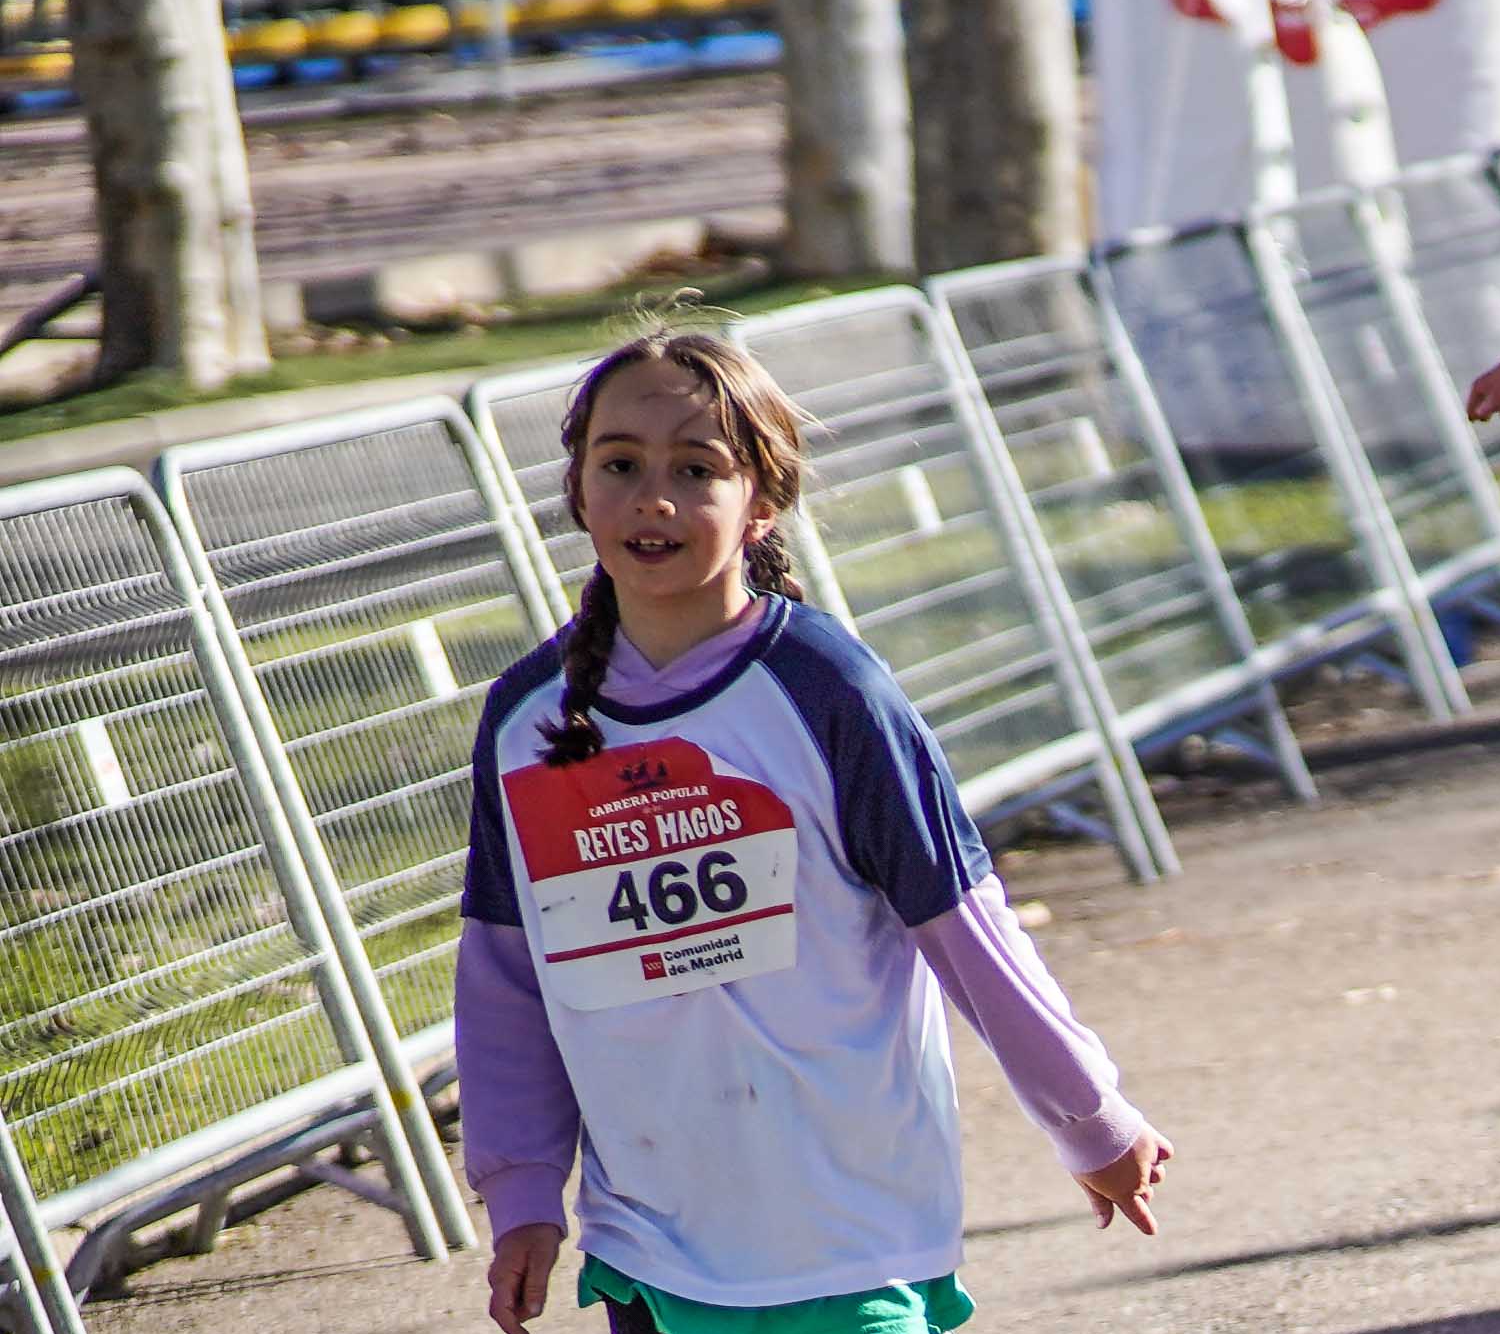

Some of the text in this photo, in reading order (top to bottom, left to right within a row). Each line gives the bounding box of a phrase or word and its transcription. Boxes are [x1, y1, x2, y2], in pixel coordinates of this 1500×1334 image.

[588, 794, 649, 817] CARRERA
[650, 785, 710, 803] POPULAR
[573, 798, 743, 862] REYES MAGOS
[608, 850, 748, 931] 466
[663, 933, 740, 961] Comunidad
[668, 948, 744, 976] de Madrid
